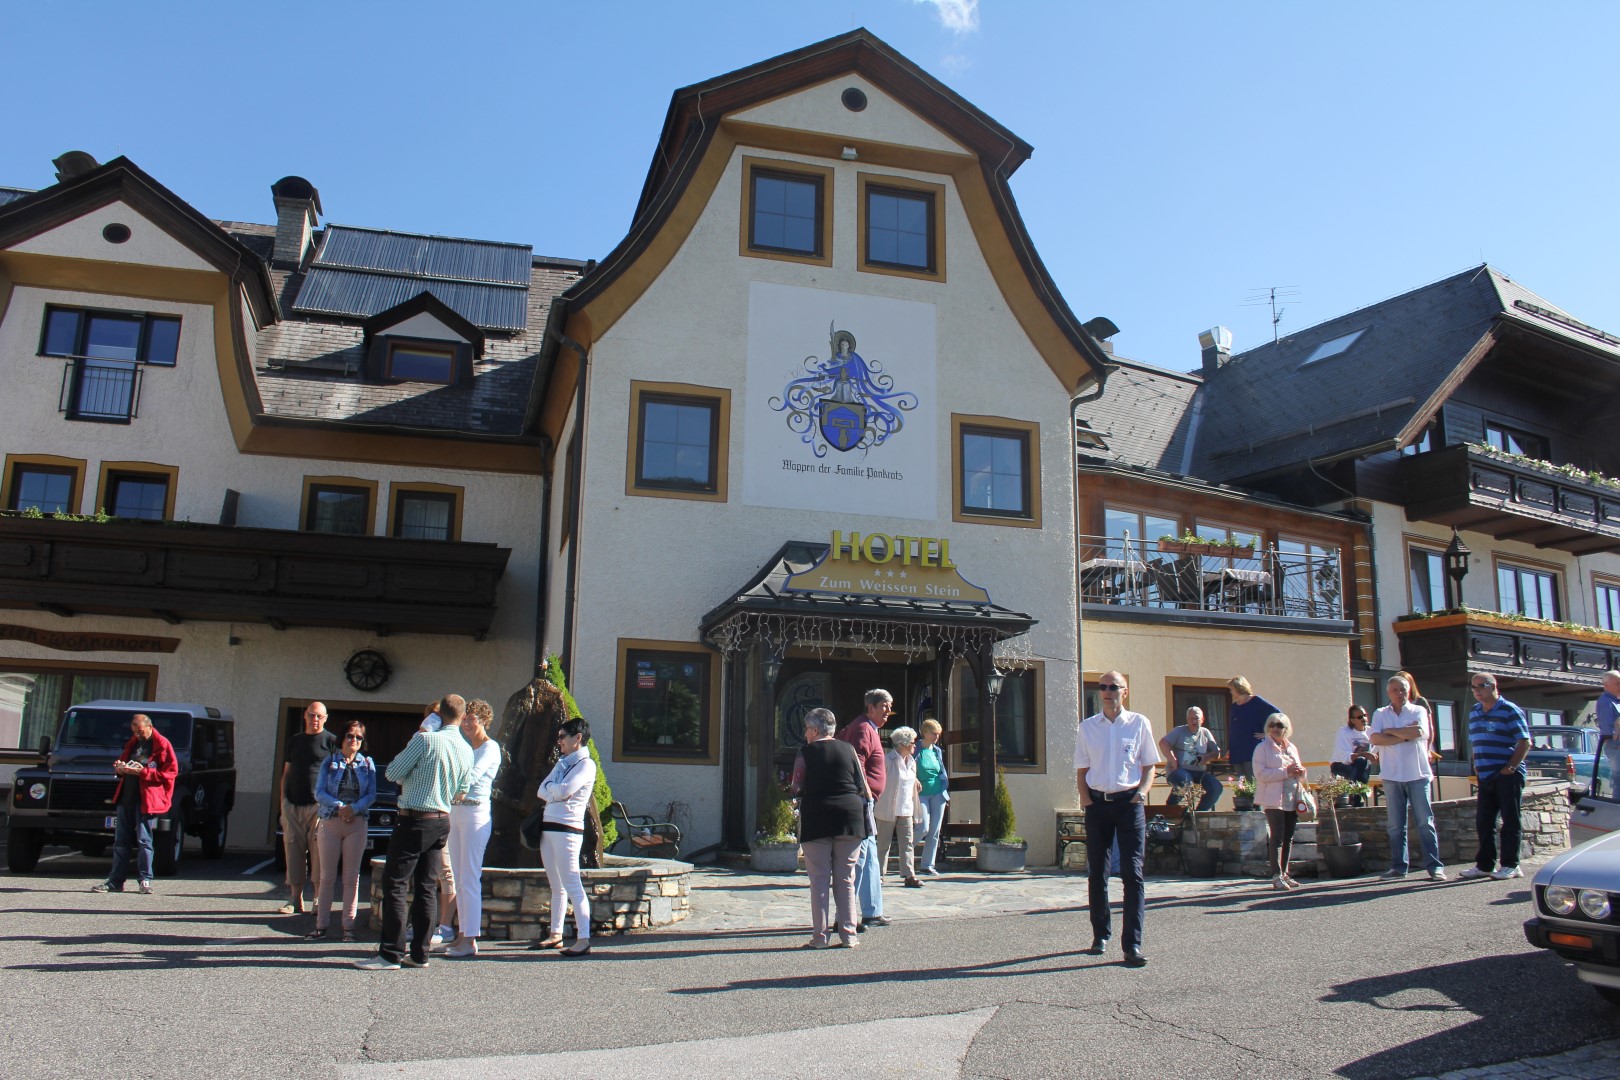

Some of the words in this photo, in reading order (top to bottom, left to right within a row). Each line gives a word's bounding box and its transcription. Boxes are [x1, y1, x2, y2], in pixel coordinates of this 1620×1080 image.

[782, 460, 815, 473] Wappen
[818, 463, 831, 474] der
[834, 465, 865, 477] Familie
[831, 529, 957, 569] HOTEL
[819, 576, 851, 589] Zum
[860, 578, 917, 594] Weissen
[925, 583, 960, 596] Stein
